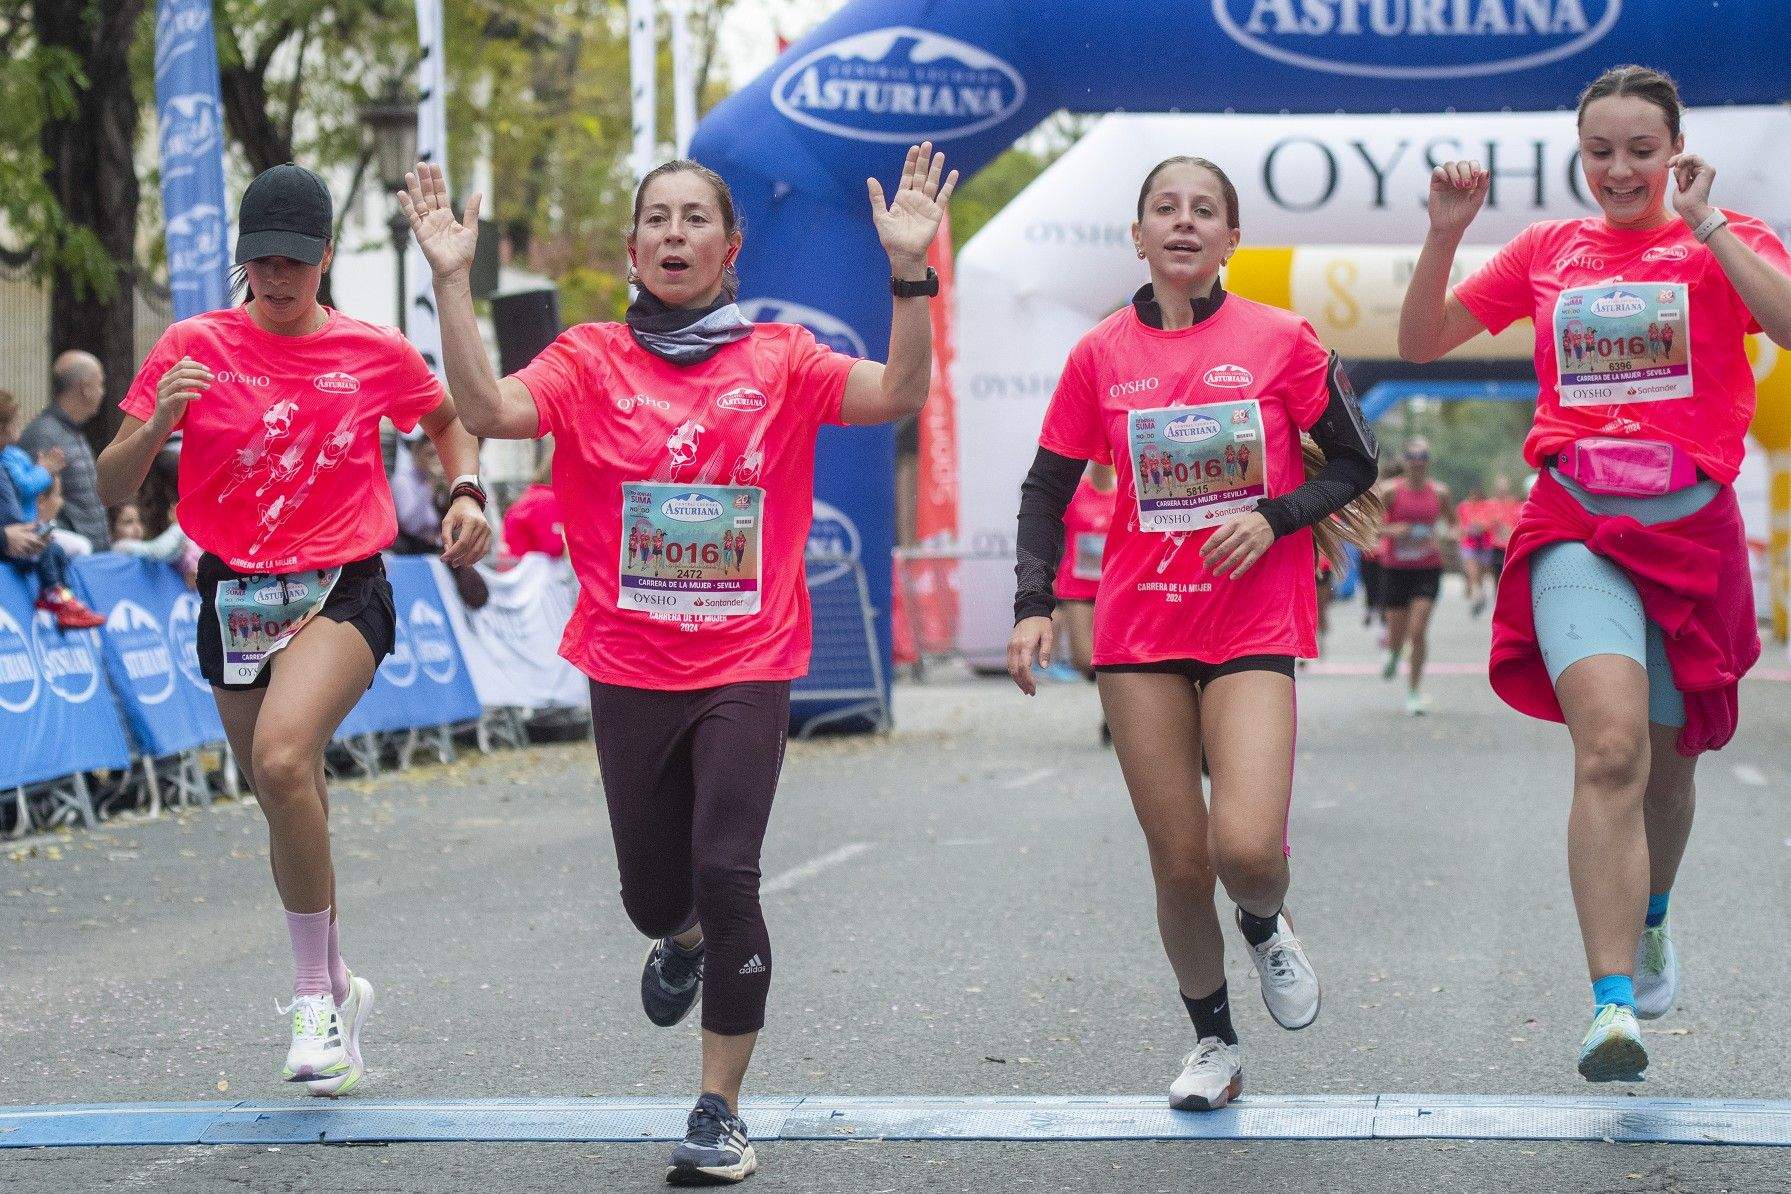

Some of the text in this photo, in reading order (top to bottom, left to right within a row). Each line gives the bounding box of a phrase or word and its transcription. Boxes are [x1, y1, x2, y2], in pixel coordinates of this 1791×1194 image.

[1245, 0, 1591, 36] ASTURIANA
[785, 65, 1004, 115] ASTURIANA
[1594, 302, 1643, 313] ASTURIANA
[1597, 336, 1645, 357] 016
[1609, 361, 1632, 371] 6396
[217, 370, 270, 387] OYSHO
[1207, 373, 1250, 384] ASTURIANA
[1620, 371, 1641, 379] MUJER
[1646, 368, 1671, 377] SEVILLA
[1109, 377, 1159, 398] OYSHO
[1573, 383, 1677, 399] OYSHO Santander
[1136, 422, 1155, 431] SUMA
[1167, 425, 1217, 438] ASTURIANA
[1174, 459, 1222, 483] 016
[1186, 485, 1209, 496] 5815
[630, 496, 651, 504] SUMA
[1198, 494, 1218, 504] MUJER
[1223, 490, 1248, 499] SEVILLA
[666, 503, 720, 516] ASTURIANA
[1154, 504, 1254, 525] OYSHO Santander
[665, 543, 720, 564] 016
[256, 561, 264, 569] DE
[265, 560, 273, 569] LA
[677, 569, 703, 579] 2472
[638, 579, 667, 588] CARRERA
[1137, 582, 1212, 592] CARRERA DE LA MUJER
[257, 589, 305, 600] ASTUANA
[633, 593, 743, 607] OYSHO Santander
[1165, 593, 1182, 602] 2024
[683, 614, 692, 622] DE
[694, 614, 703, 622] LA
[680, 623, 699, 632] 2024
[738, 965, 766, 974] adidas
